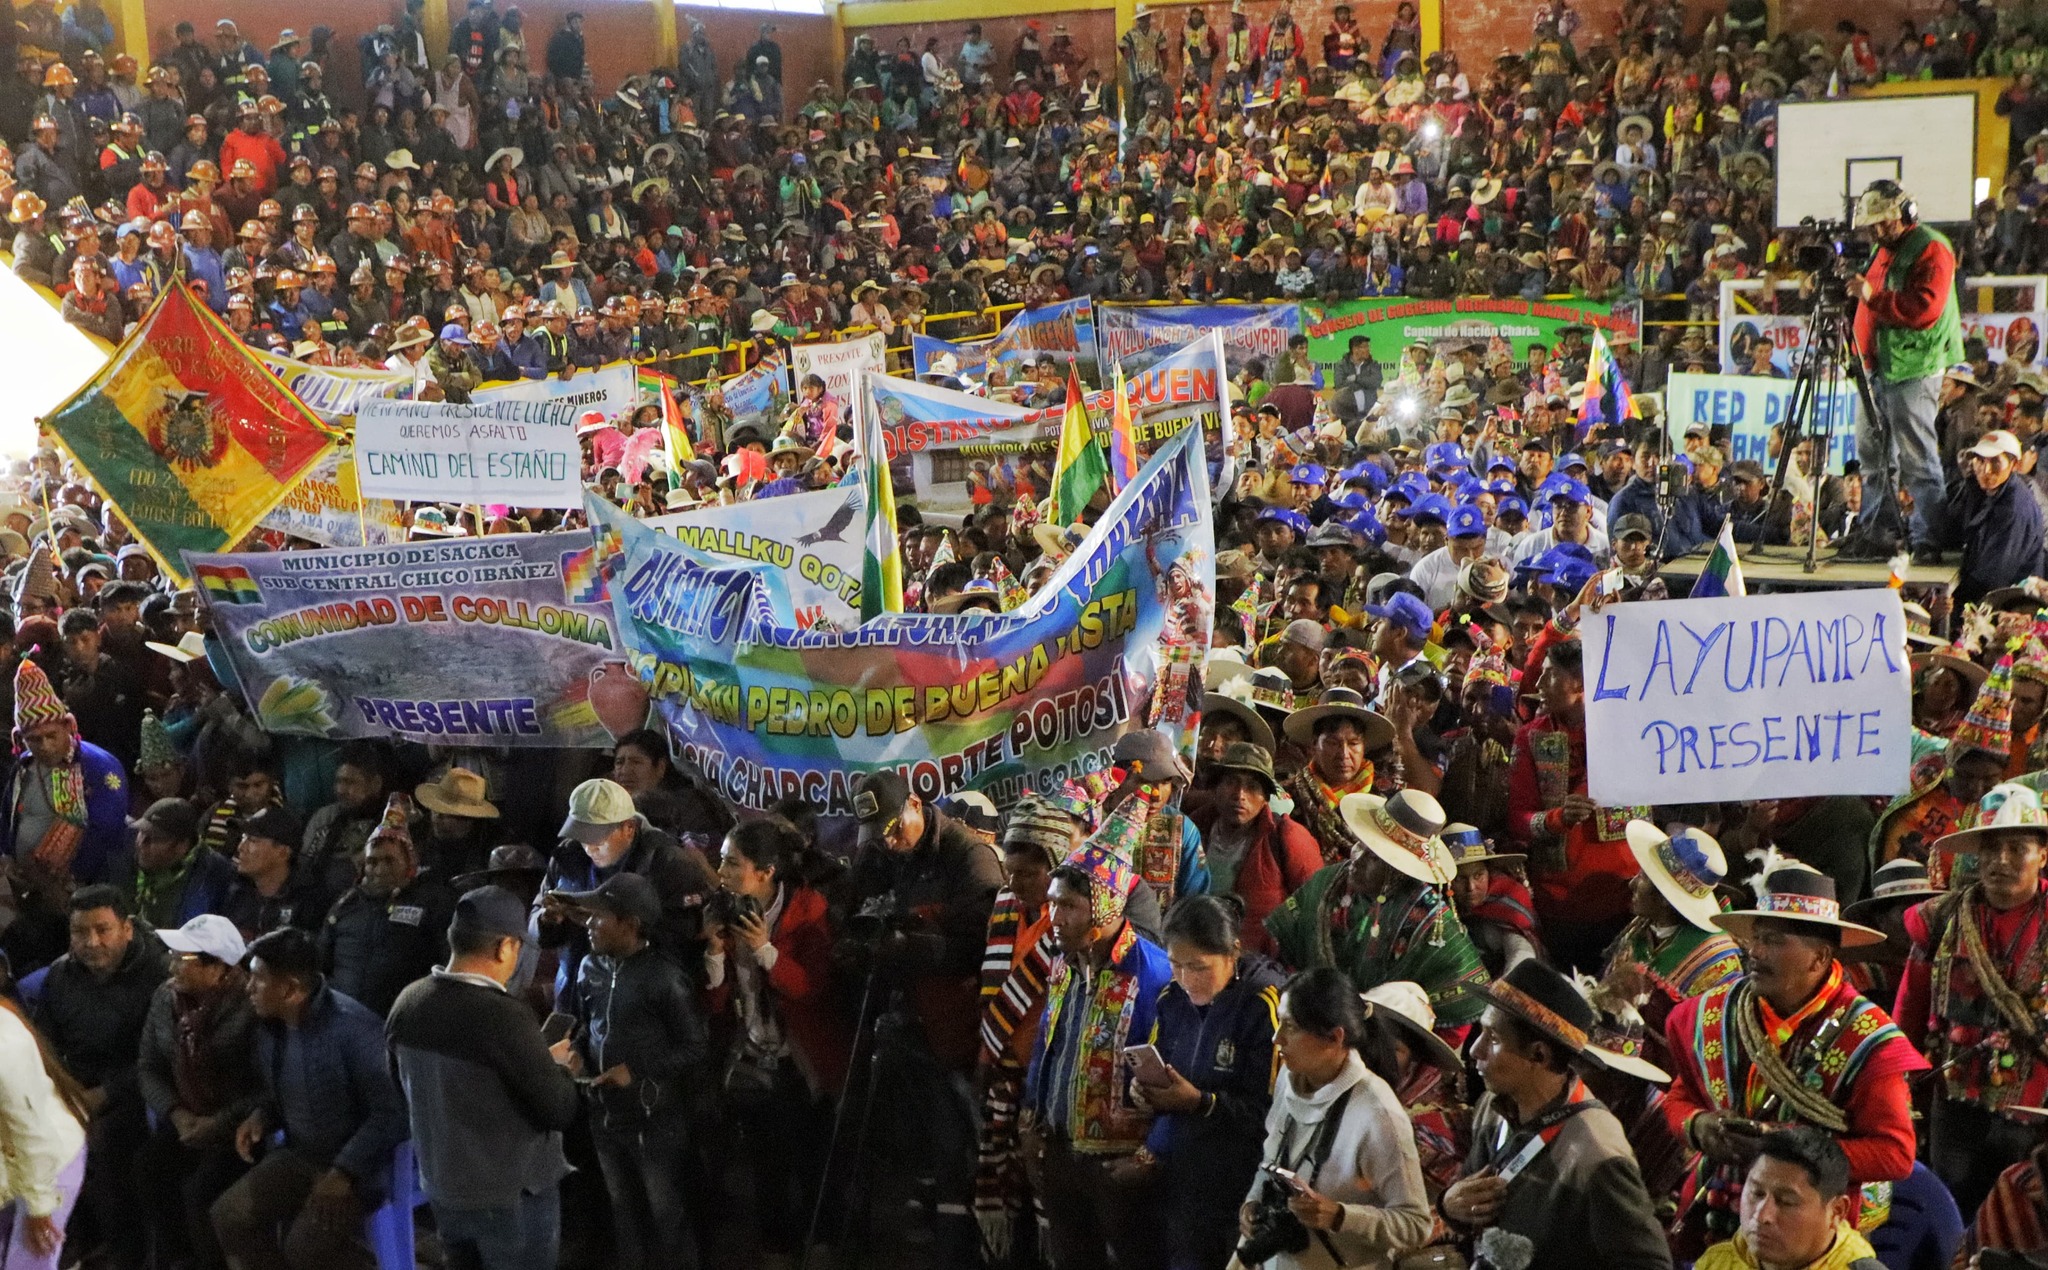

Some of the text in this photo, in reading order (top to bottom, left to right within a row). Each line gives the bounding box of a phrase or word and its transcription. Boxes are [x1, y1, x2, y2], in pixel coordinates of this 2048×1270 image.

[1367, 308, 1384, 324] DE
[1404, 326, 1441, 338] Capital
[567, 389, 607, 406] MINEROS
[1693, 389, 1746, 426] RED
[400, 424, 527, 441] QUEREMOS ASFALTO
[1154, 417, 1194, 439] BUEN
[368, 449, 566, 481] CAMINO DEL ESTAÑO
[282, 544, 519, 571] MUNICIPIO DE SACACA
[677, 526, 861, 610] MALLKU QOTA
[263, 562, 556, 592] SUB CENTRAL CHICO IBAÑEZ
[247, 595, 613, 654] COMUNIDAD DE COLLOMA
[1593, 612, 1900, 702] LAYUPAMPA
[747, 686, 858, 738] PEDRO
[866, 686, 916, 737] DE
[925, 645, 1050, 724] BUENA
[363, 699, 541, 735] PRESENTE
[726, 756, 862, 818] CHARCA
[1011, 653, 1130, 759] POTOSÍ
[1641, 710, 1881, 775] PRESENTE
